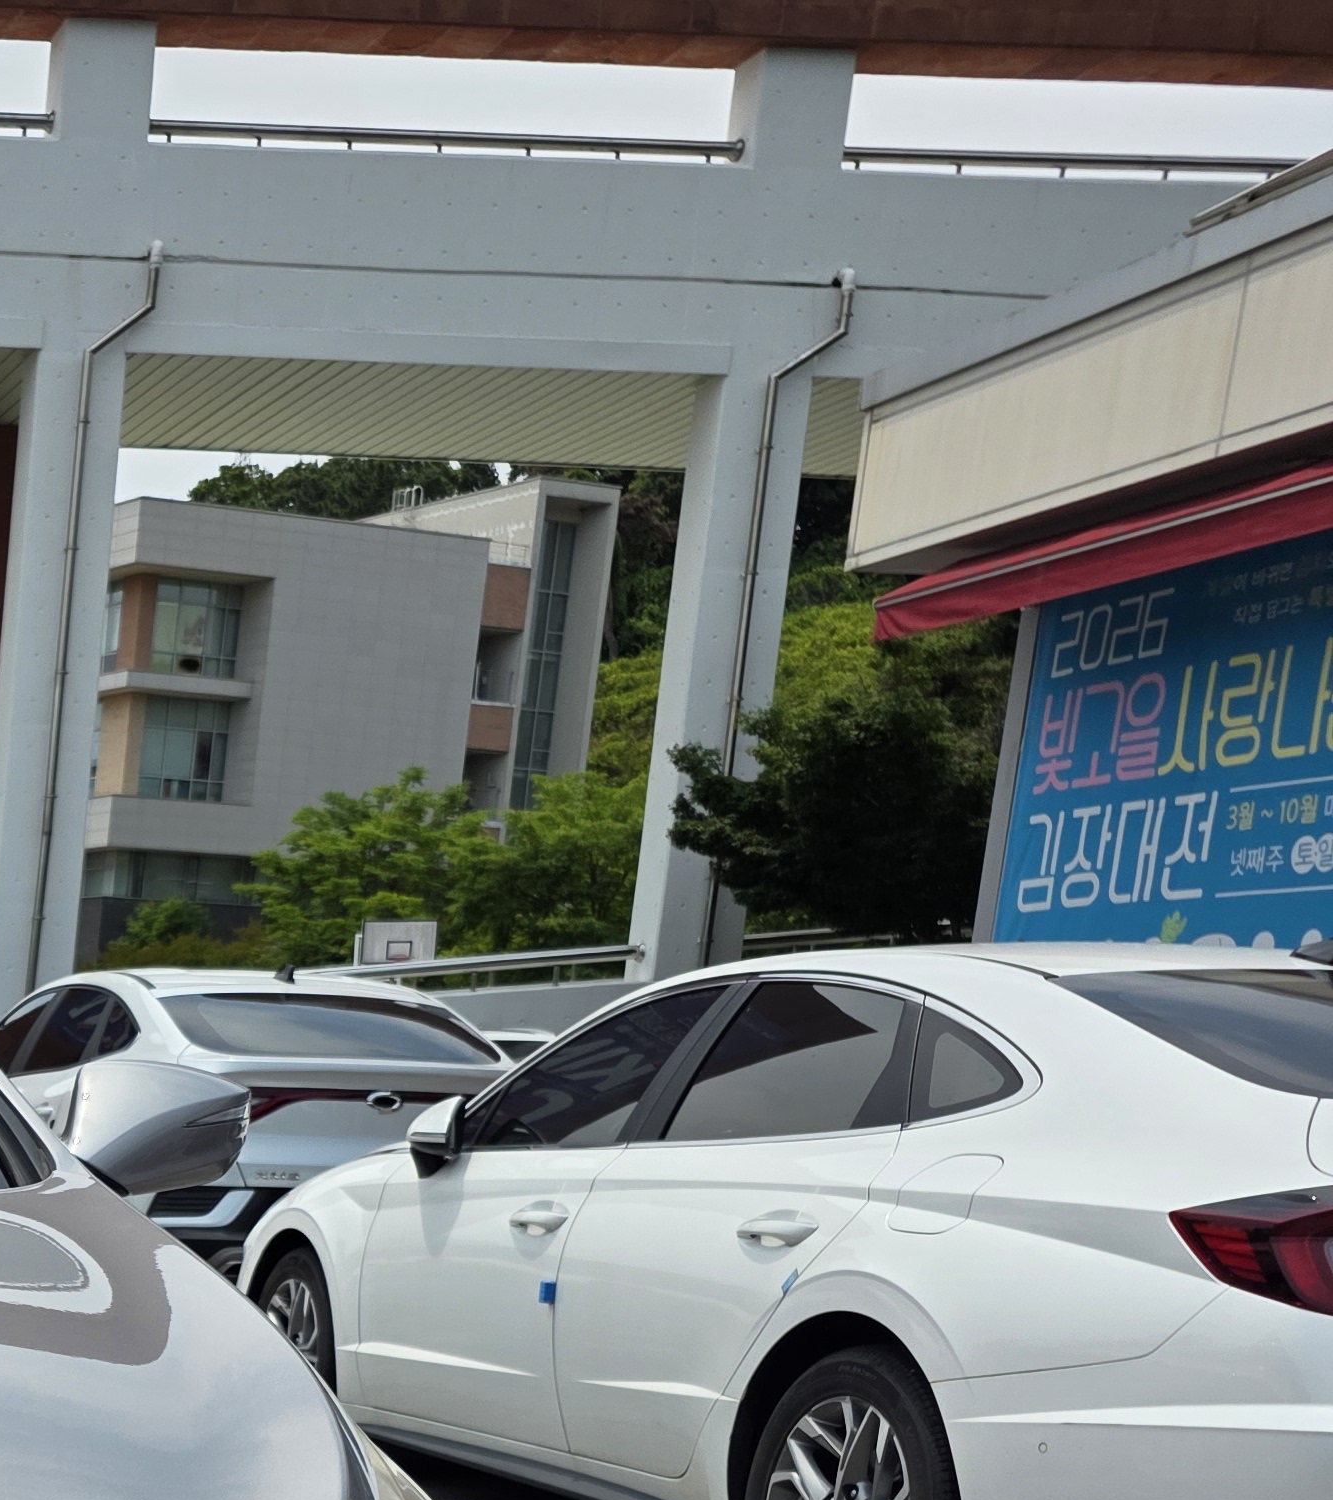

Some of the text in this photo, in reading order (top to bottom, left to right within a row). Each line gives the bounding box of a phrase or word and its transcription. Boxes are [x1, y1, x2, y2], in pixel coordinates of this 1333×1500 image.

[1051, 587, 1176, 678] 2026
[1226, 801, 1255, 831] 3월
[1279, 794, 1319, 825] 10월
[1017, 790, 1219, 913] 김장대전
[1230, 845, 1284, 877] 넷째주
